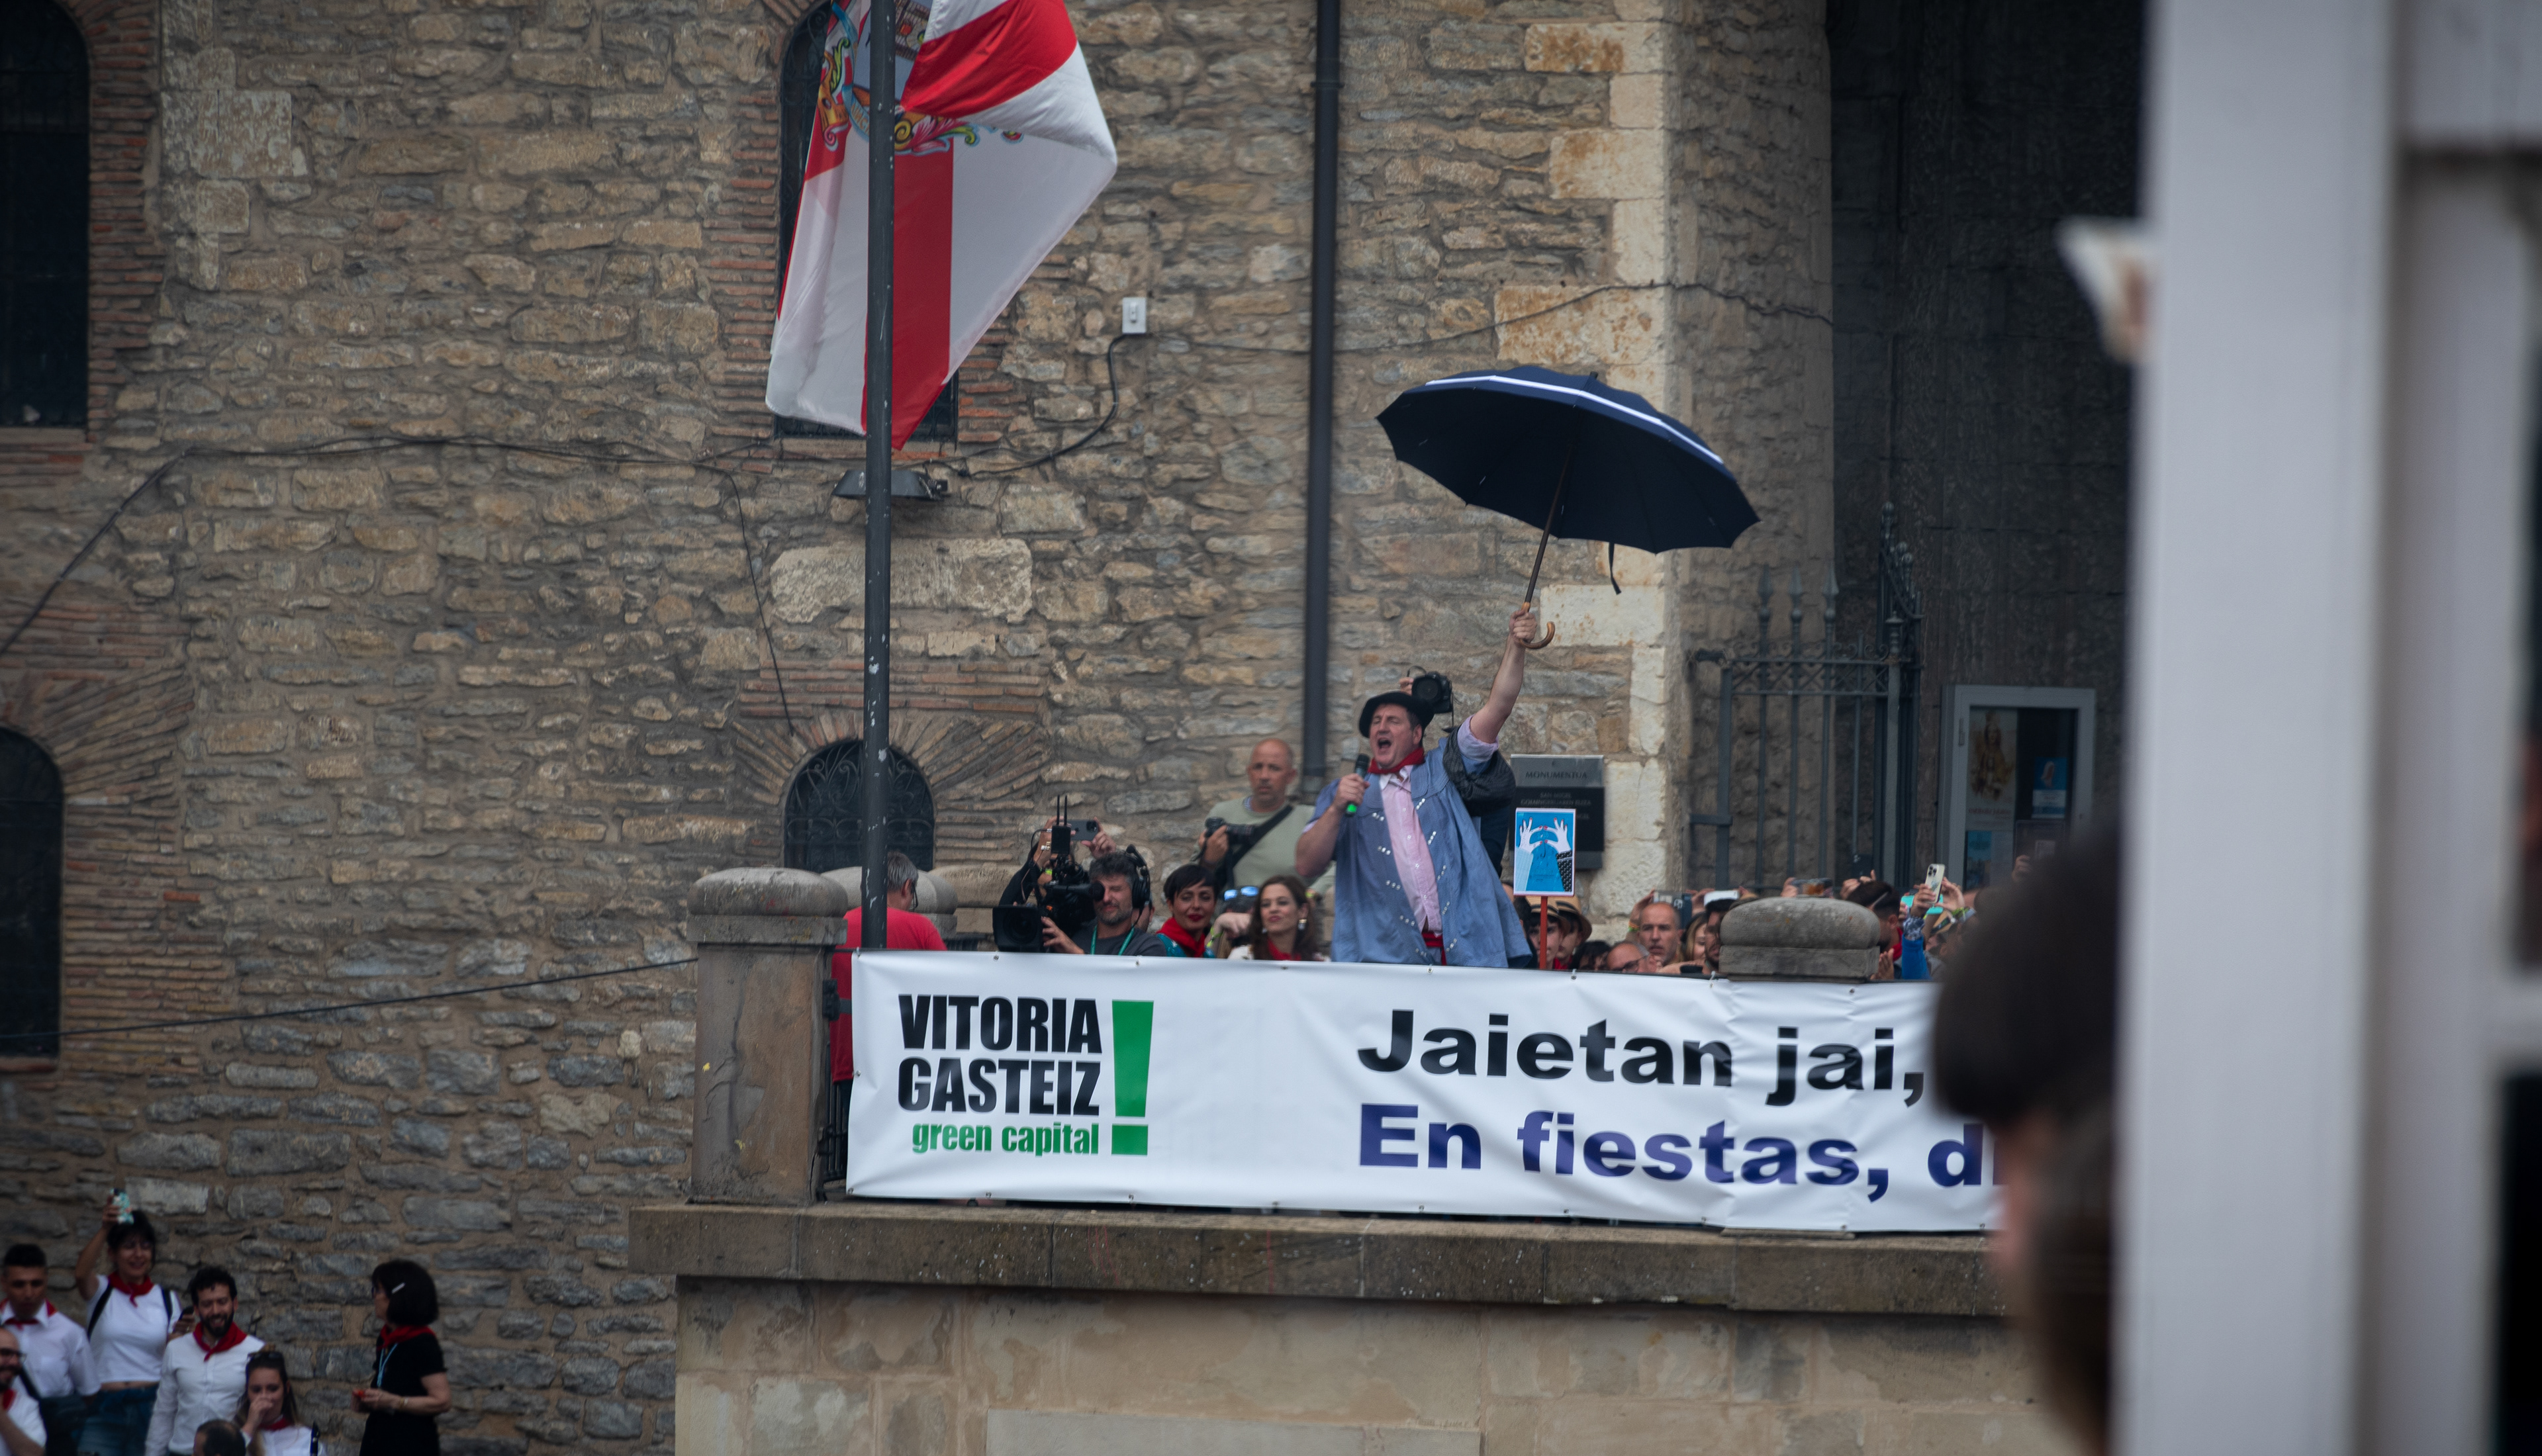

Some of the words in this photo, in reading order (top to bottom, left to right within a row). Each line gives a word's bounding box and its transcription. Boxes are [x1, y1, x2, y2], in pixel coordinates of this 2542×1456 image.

[898, 994, 1102, 1054] VITORIA
[898, 1057, 1102, 1116] GASTEIZ
[1357, 1009, 1733, 1087] Jaietan
[1765, 1026, 1925, 1107] jai,
[912, 1123, 992, 1154] green
[1001, 1122, 1100, 1158] capital
[1360, 1103, 1482, 1169] En
[1517, 1111, 1889, 1203] fiestas,
[1927, 1122, 2008, 1188] d
